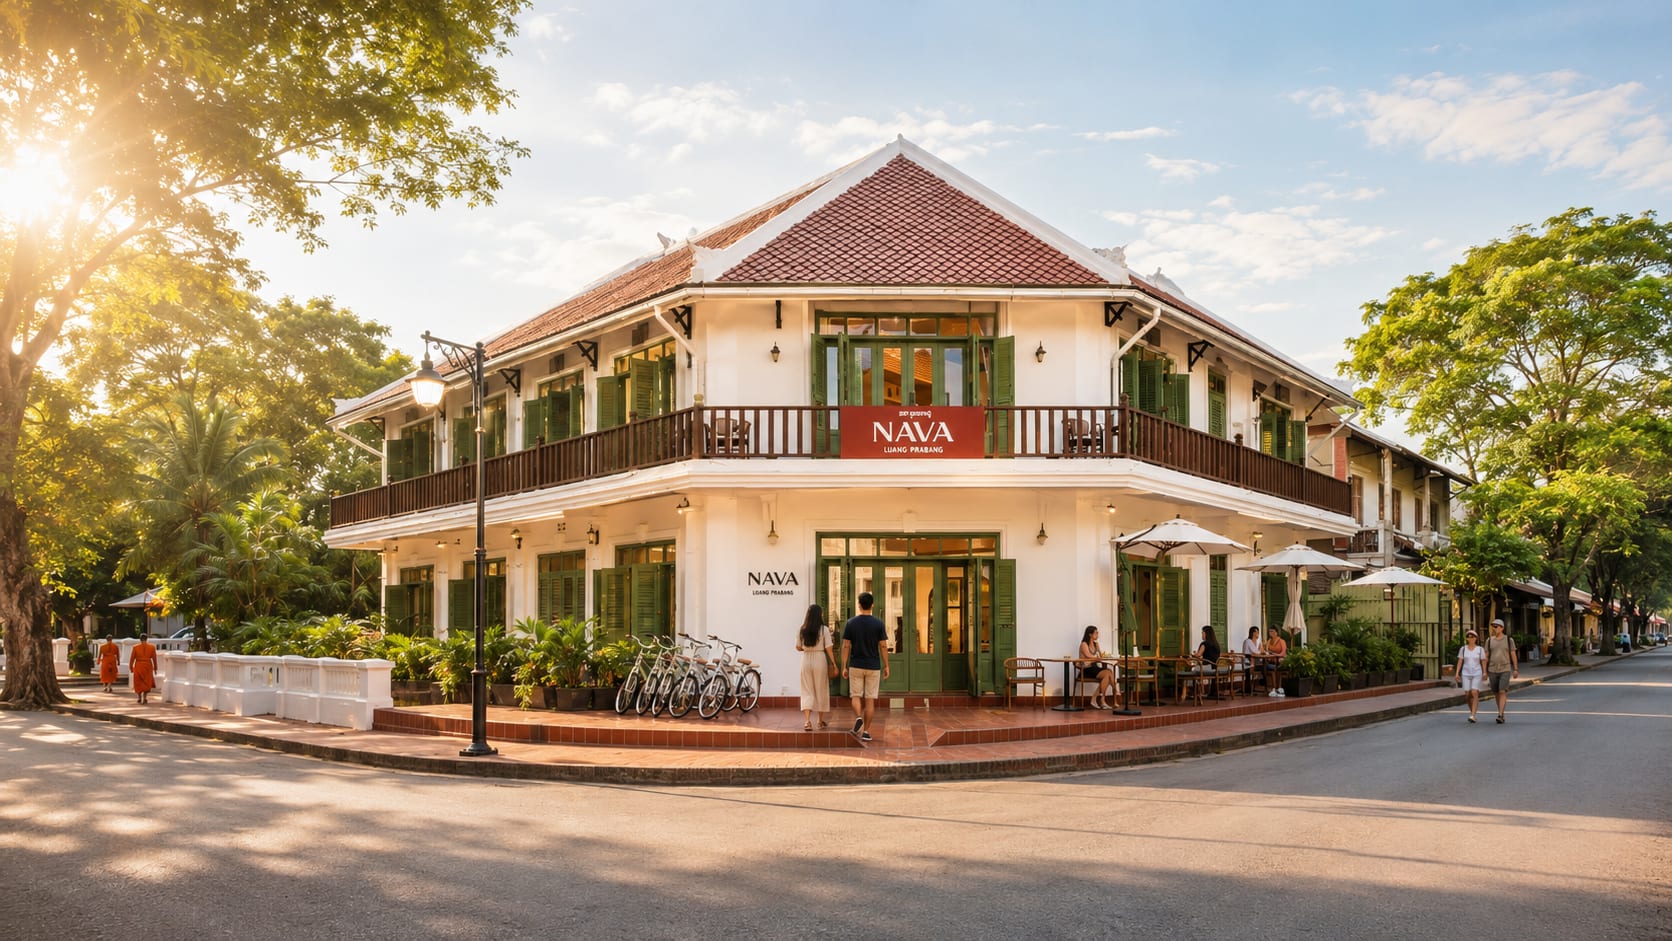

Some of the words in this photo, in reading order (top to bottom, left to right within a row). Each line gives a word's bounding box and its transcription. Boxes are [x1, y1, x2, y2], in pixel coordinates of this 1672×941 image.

[873, 421, 954, 442] NAVA
[883, 446, 908, 454] LUANG
[910, 446, 944, 454] PRABANG
[748, 571, 799, 586] NAVA
